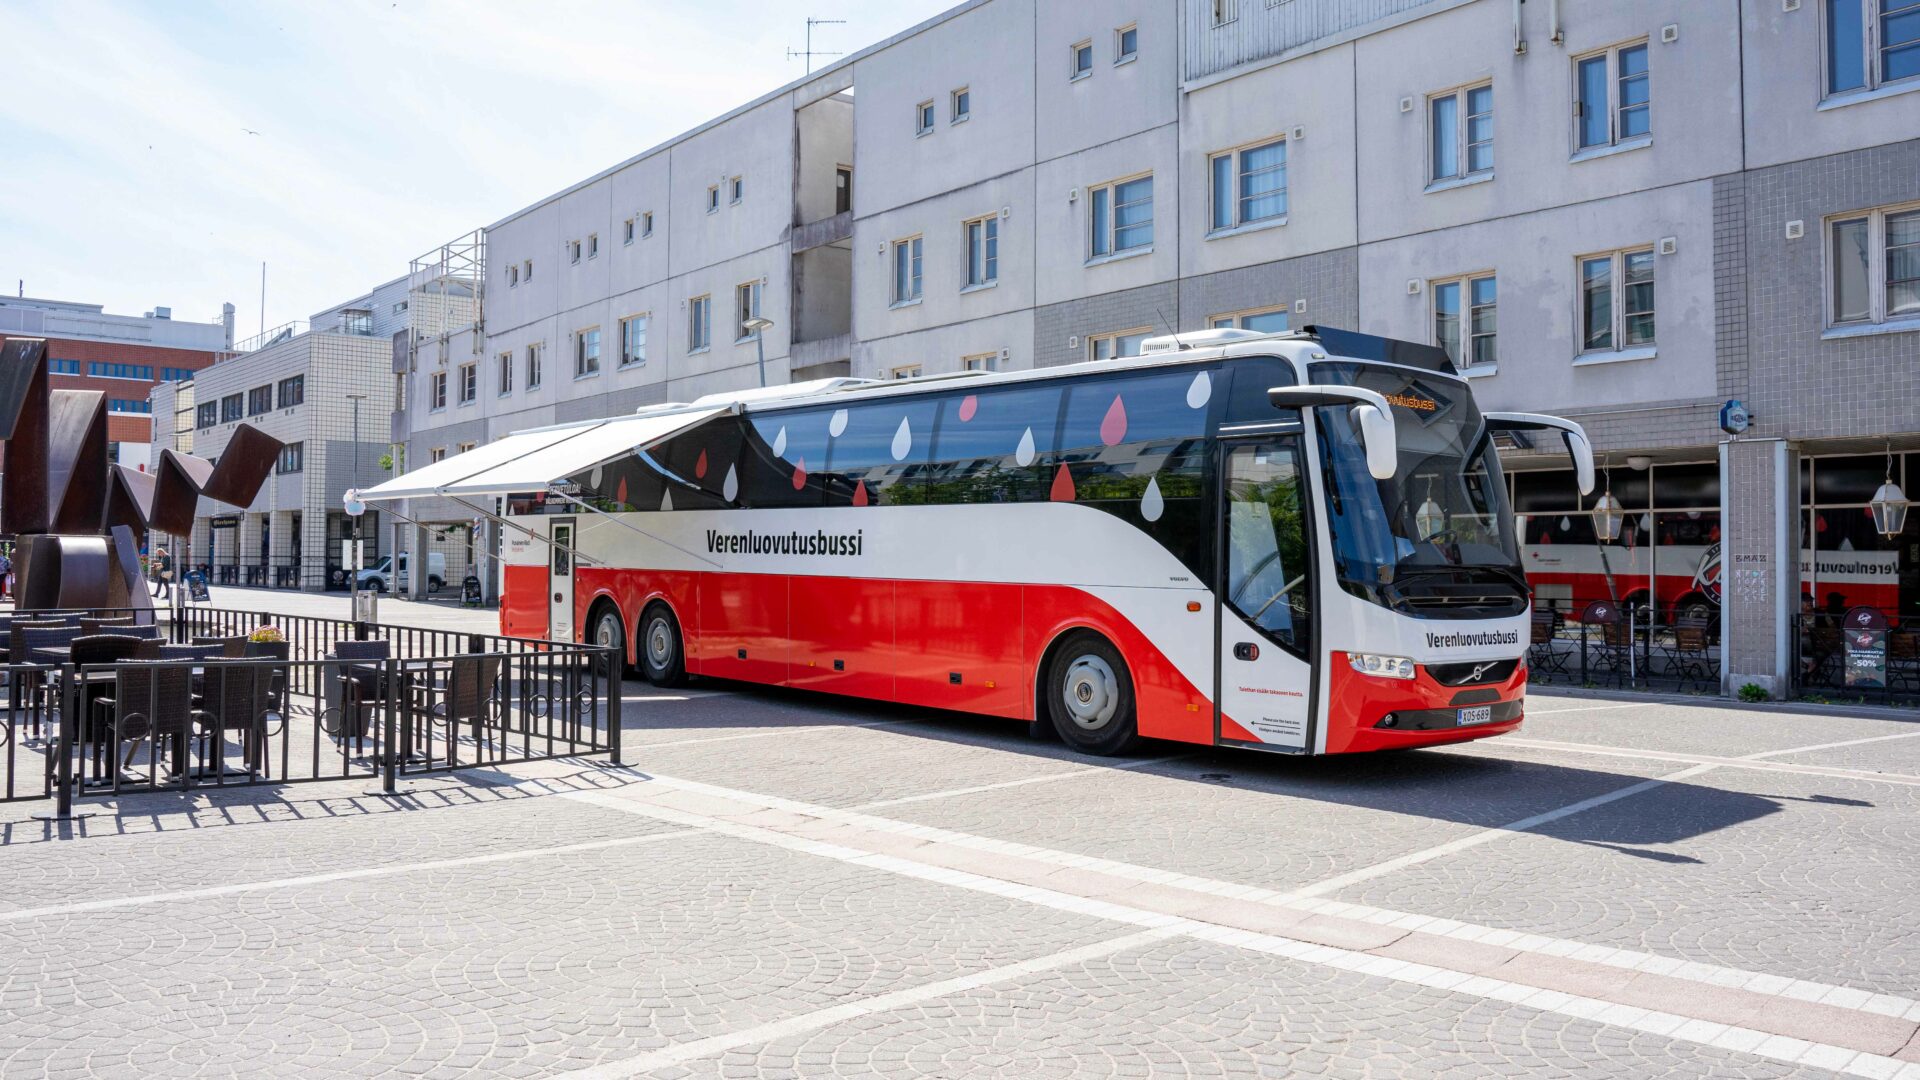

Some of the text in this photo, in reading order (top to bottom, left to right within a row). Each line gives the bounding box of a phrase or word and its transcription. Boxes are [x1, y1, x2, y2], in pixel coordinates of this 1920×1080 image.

[706, 529, 862, 556] Verenluovutusbussi
[1426, 629, 1518, 648] Verenluovutusbussi
[1853, 659, 1877, 667] -50%
[1463, 709, 1489, 722] XOS-689
